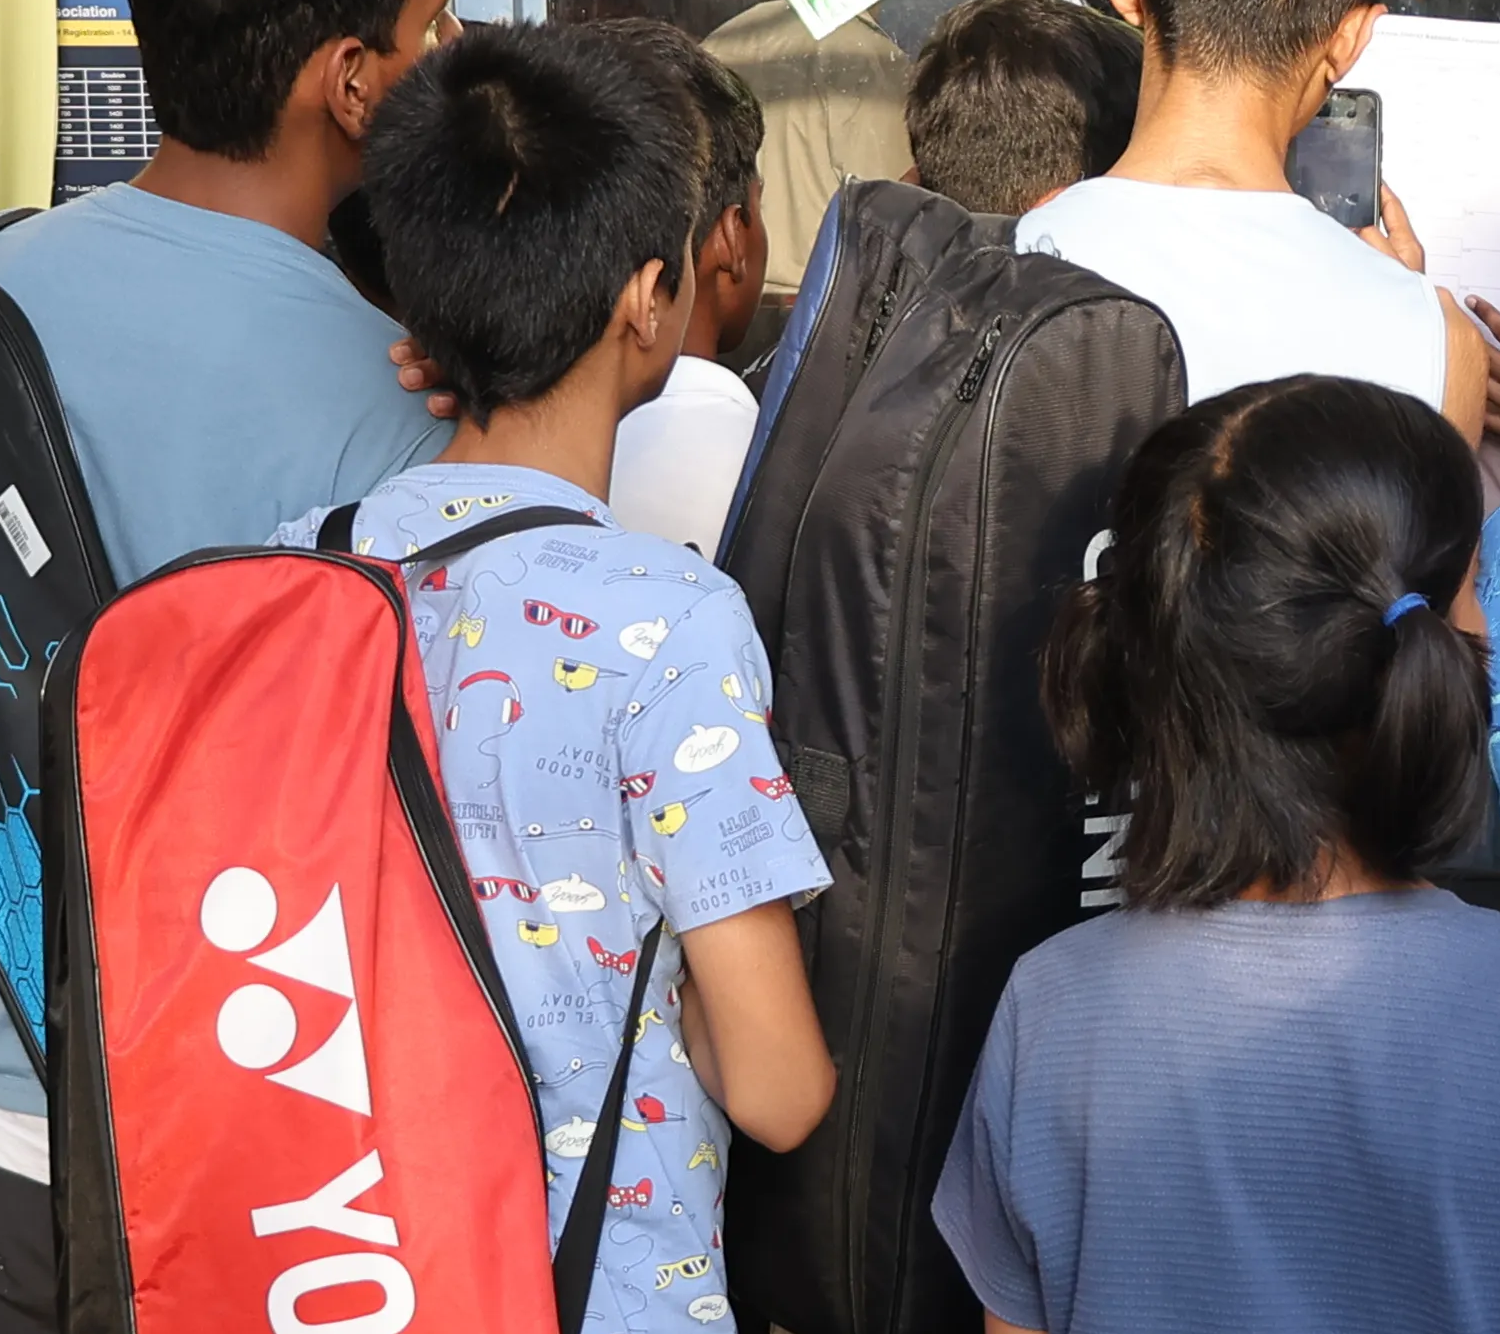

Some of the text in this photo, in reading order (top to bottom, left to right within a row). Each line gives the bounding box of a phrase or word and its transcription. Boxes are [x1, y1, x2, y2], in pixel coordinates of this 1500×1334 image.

[697, 867, 750, 893] TODAY
[690, 878, 773, 914] FEEL GOOD
